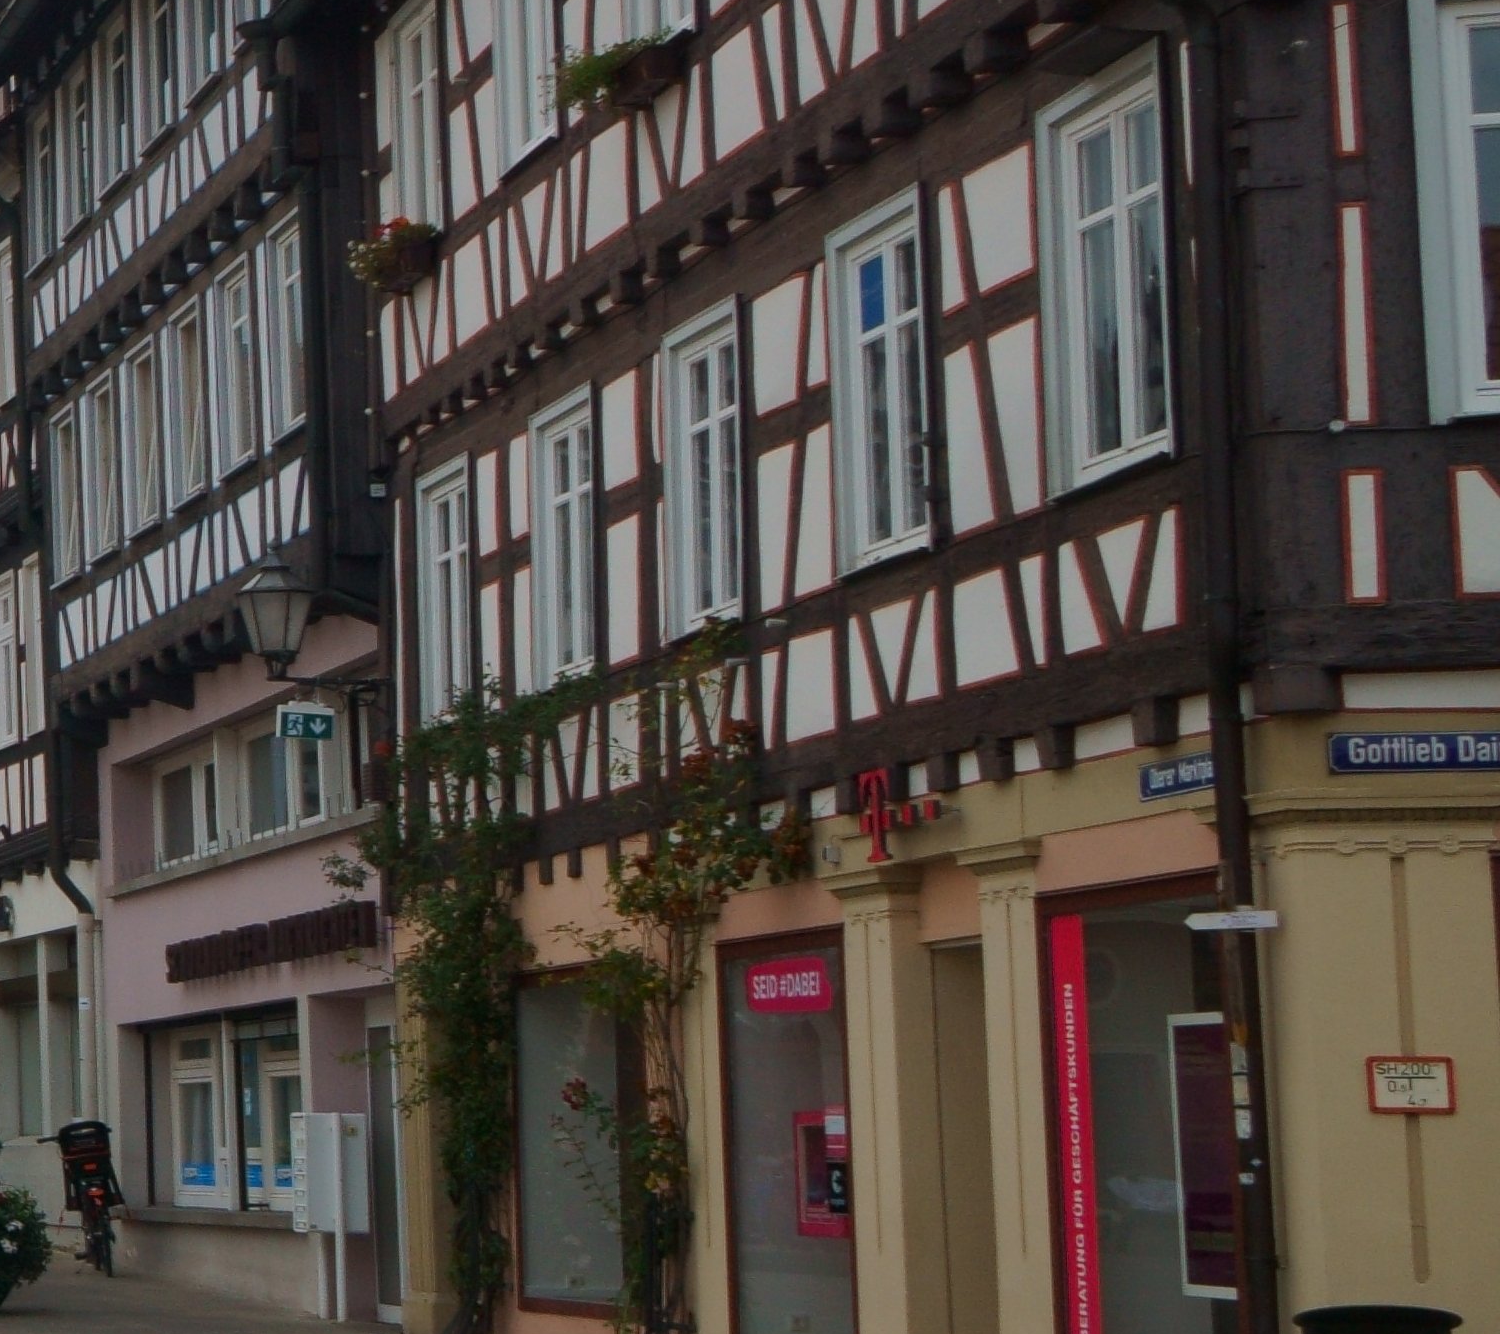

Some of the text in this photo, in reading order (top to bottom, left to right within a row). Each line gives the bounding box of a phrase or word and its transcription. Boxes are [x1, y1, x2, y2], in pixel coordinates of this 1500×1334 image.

[1348, 735, 1500, 764] Gottlieb Dai
[752, 971, 821, 1000] SEID #DABEI
[1063, 983, 1083, 1185] GESCHÄFTSKUNDEN
[1073, 1189, 1085, 1229] FÜR
